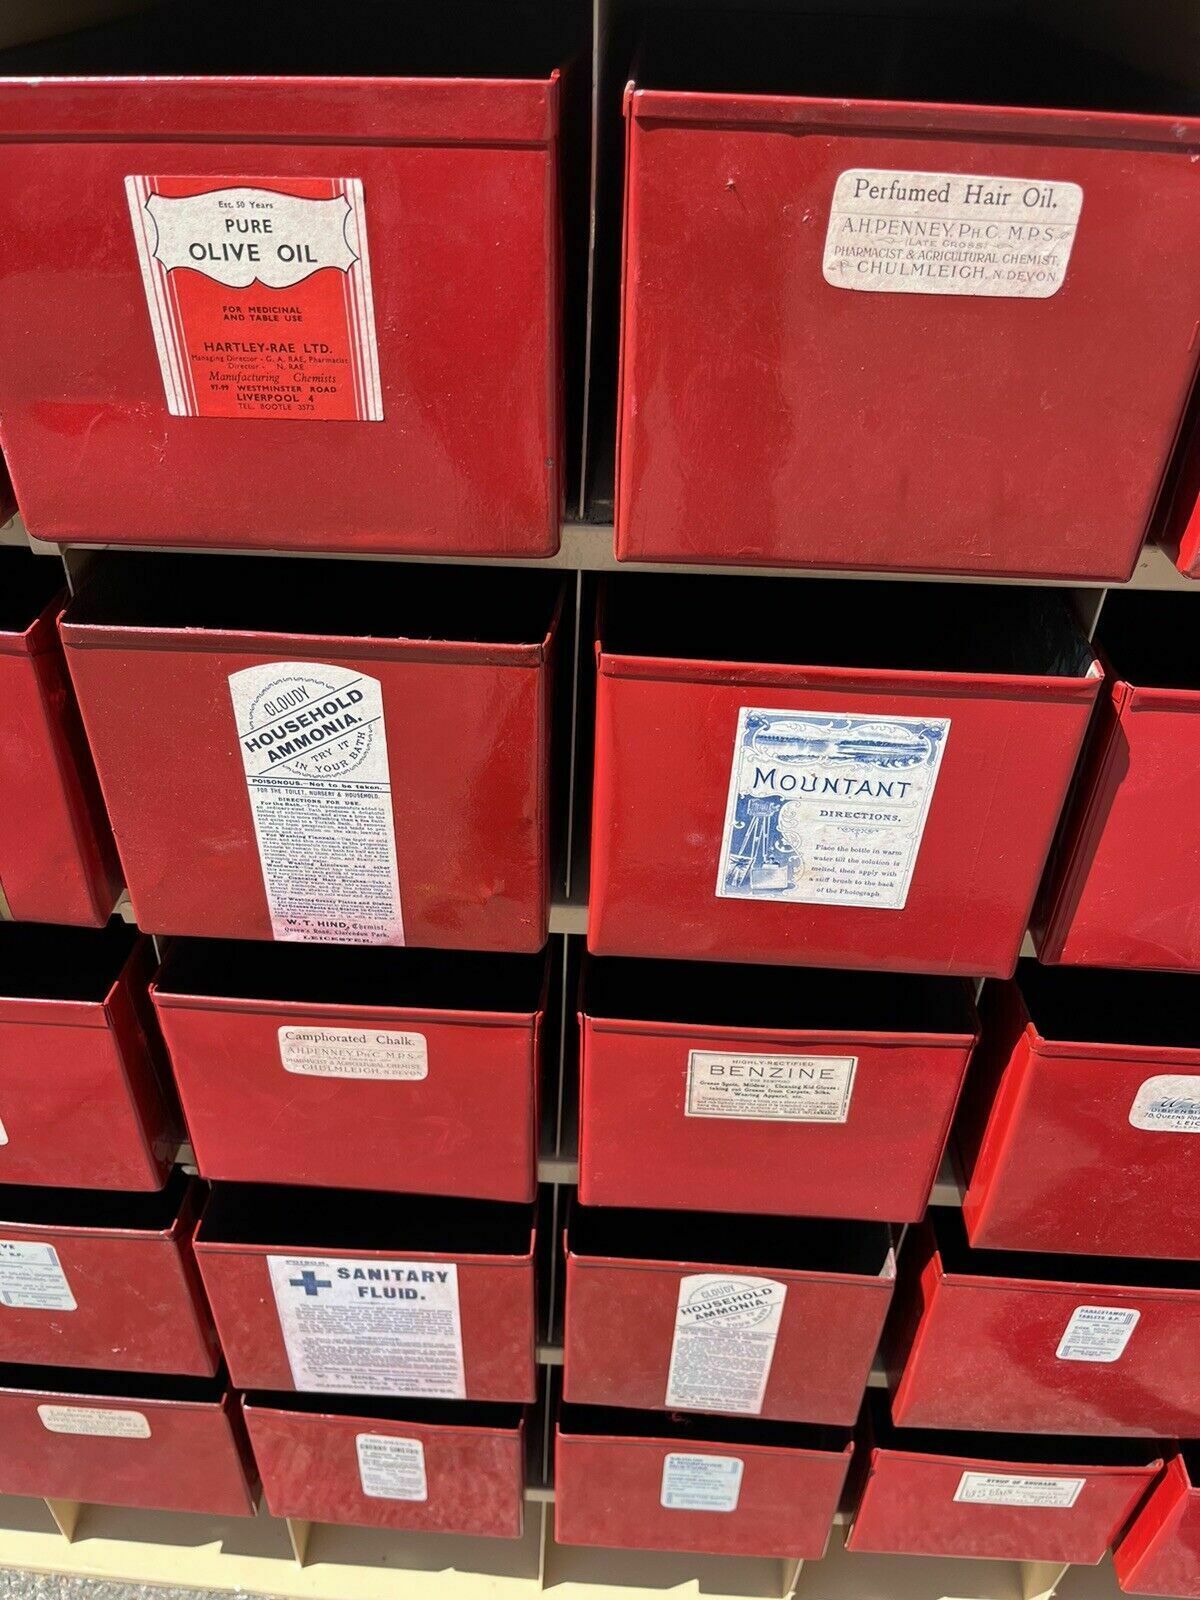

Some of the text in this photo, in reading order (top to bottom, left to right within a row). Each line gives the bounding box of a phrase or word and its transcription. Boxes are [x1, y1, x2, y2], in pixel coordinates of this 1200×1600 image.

[854, 178, 1057, 209] Perfumed Hair Oil.
[236, 201, 246, 209] 50
[249, 201, 273, 210] Years
[226, 218, 273, 233] PURE
[189, 242, 318, 262] OLIVE OIL
[834, 246, 902, 260] PHARMACIST
[918, 250, 998, 263] AGRICULTURAL
[248, 306, 301, 314] MEDICINAL
[250, 314, 278, 322] TABLE
[204, 342, 332, 354] HARTLEY-RAE LTD.
[192, 354, 224, 362] Managing
[209, 371, 336, 384] Manufacturing Chemists
[236, 394, 299, 402] LIVERPOOL
[264, 686, 310, 716] CLOUDY
[244, 689, 364, 752] HOUSEHOLD
[268, 713, 362, 763] AMMONIA.
[296, 732, 365, 773] IN YOUR BATH
[311, 740, 350, 762] TRY IT
[752, 767, 911, 798] MOUNTANT
[819, 810, 901, 822] DIRECTIONS.
[286, 1032, 415, 1046] Camphorated Chalk.
[710, 1065, 834, 1079] BENZINE
[337, 1268, 448, 1283] SANITARY
[358, 1287, 425, 1300] FLUID.
[701, 1284, 735, 1299] CLOUDY
[681, 1288, 772, 1315] HOUSEHOLD
[695, 1300, 768, 1320] AMMONIA.
